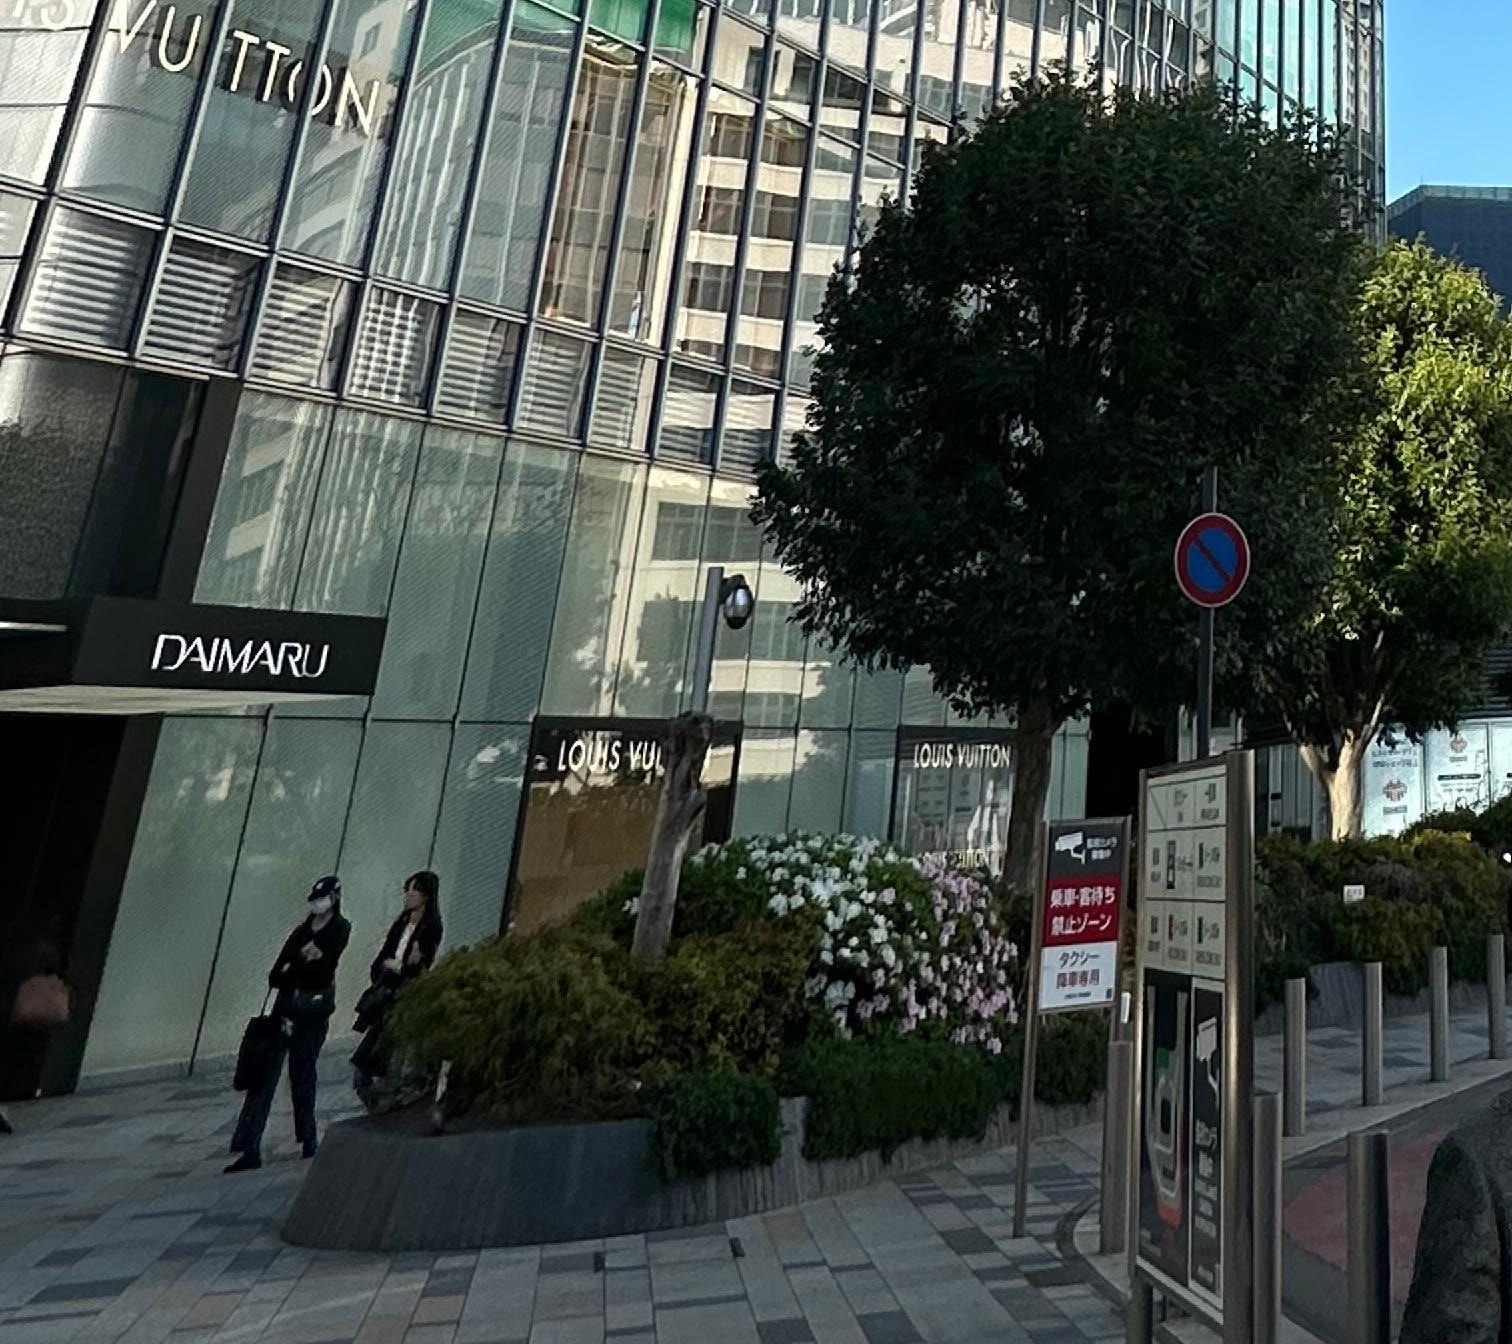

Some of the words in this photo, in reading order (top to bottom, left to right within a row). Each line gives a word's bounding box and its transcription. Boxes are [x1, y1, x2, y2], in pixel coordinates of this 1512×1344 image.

[151, 633, 330, 679] DAIMARU
[558, 738, 622, 773] LOUIS
[914, 743, 954, 769] LOUIS
[957, 743, 1012, 769] VUITTON
[1059, 950, 1101, 969] タクシー
